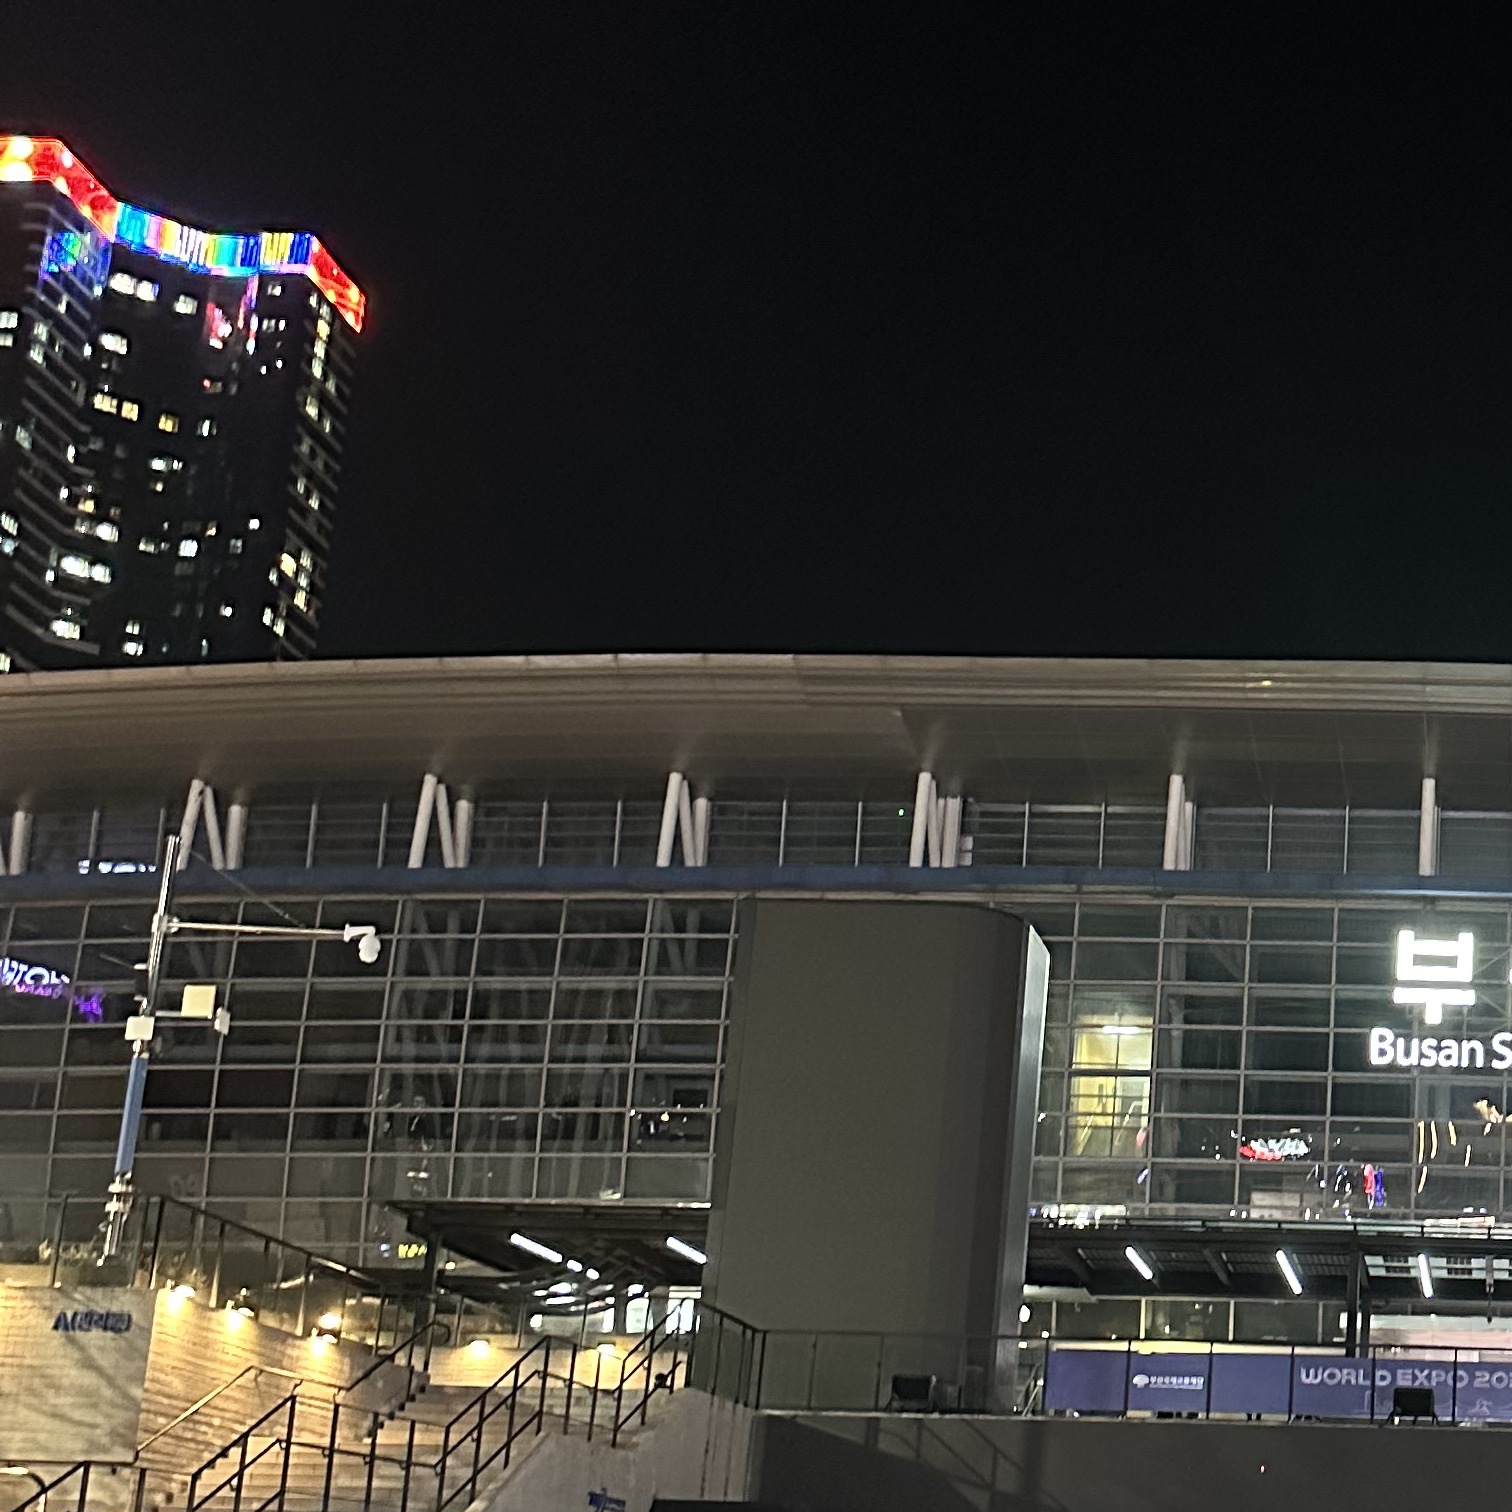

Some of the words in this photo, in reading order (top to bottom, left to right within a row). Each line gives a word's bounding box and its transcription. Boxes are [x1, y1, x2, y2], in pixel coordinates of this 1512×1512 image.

[1369, 1027, 1485, 1069] Busan
[1300, 1366, 1392, 1387] WORLD
[1396, 1368, 1470, 1388] EXPO
